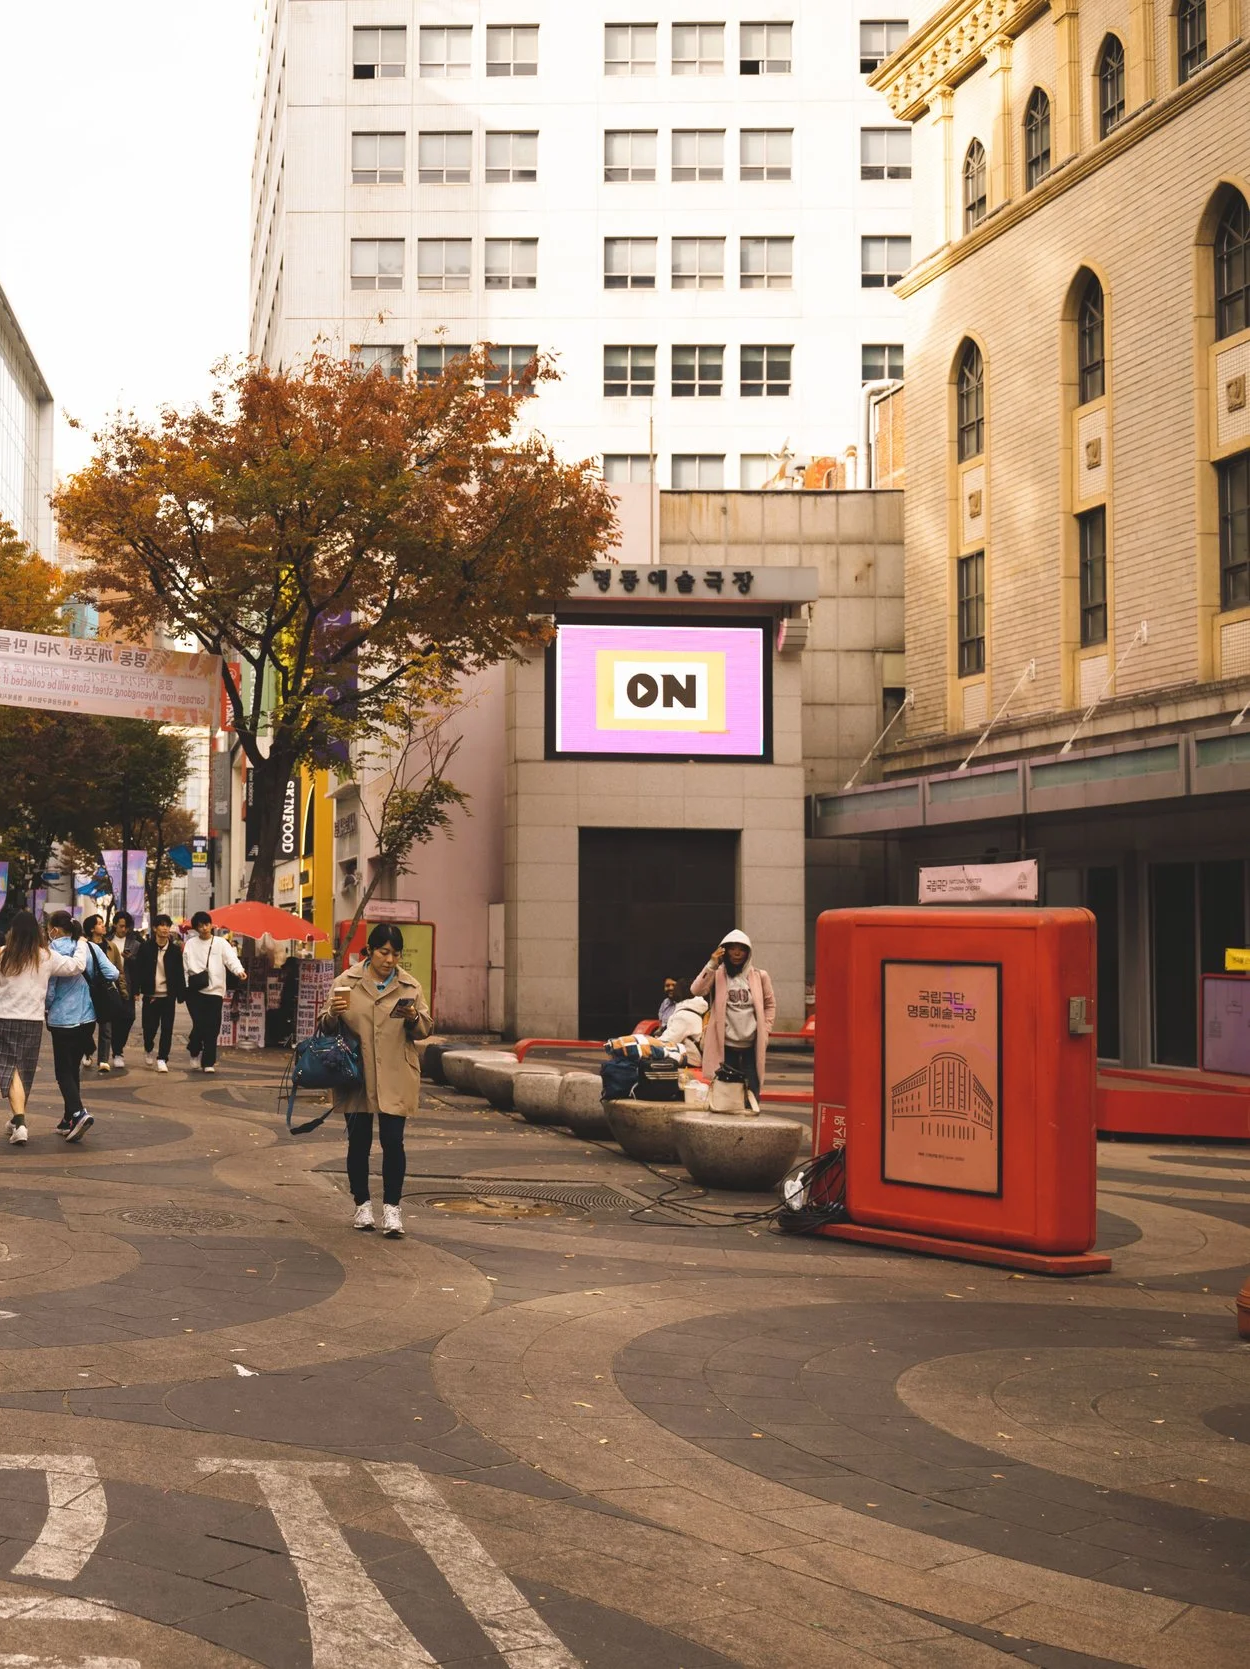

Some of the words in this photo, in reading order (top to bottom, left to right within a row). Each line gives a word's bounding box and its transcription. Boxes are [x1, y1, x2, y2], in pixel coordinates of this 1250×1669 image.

[592, 569, 754, 594] 명동예술극장
[626, 672, 697, 709] ON
[281, 780, 295, 854] SKINFOOD
[918, 990, 965, 1006] 국립극단
[907, 1005, 977, 1022] 명동예술극장
